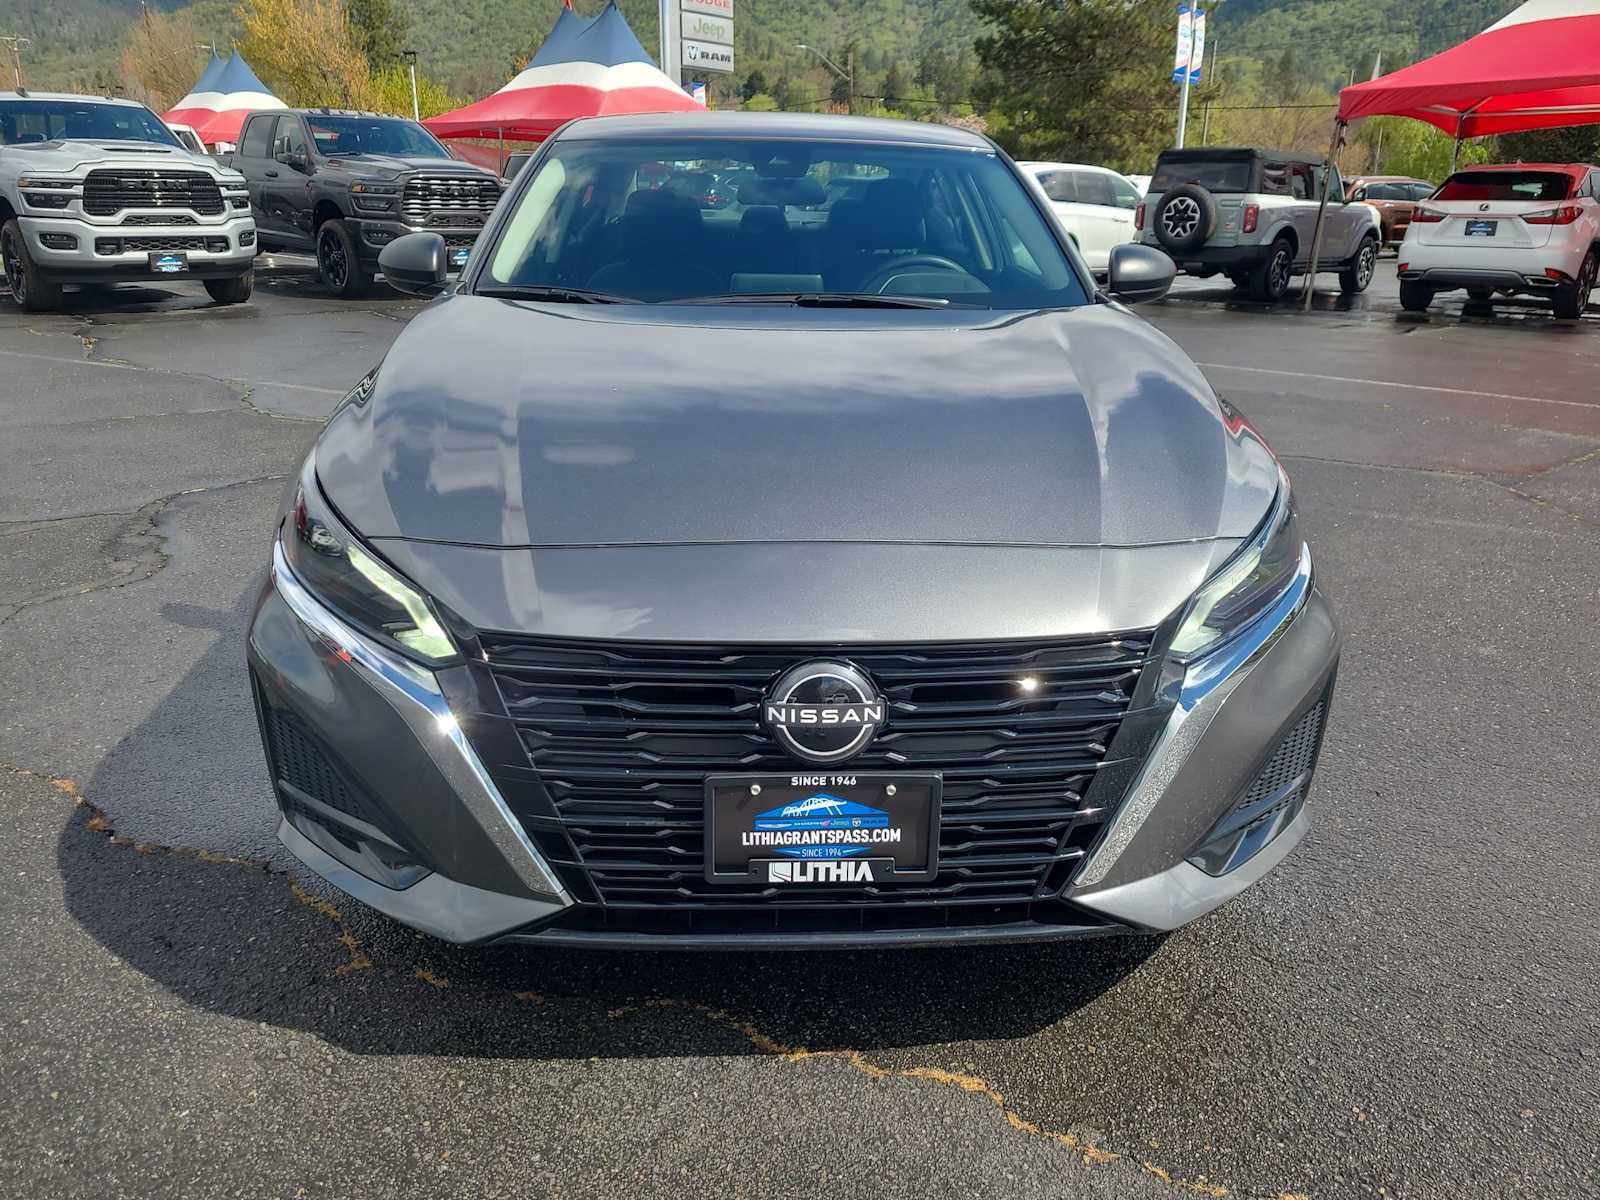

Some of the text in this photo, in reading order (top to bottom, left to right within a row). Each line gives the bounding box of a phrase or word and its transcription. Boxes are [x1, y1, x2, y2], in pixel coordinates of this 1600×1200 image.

[689, 0, 731, 8] DGE
[693, 17, 726, 40] Jeep
[700, 51, 731, 62] RAM
[767, 706, 881, 723] NISSAN
[791, 776, 857, 786] SINCE 1946
[742, 828, 901, 846] LITHIAGRANTSPASS.COM
[801, 847, 842, 858] SINCE 1994
[792, 861, 875, 882] LITHIA
